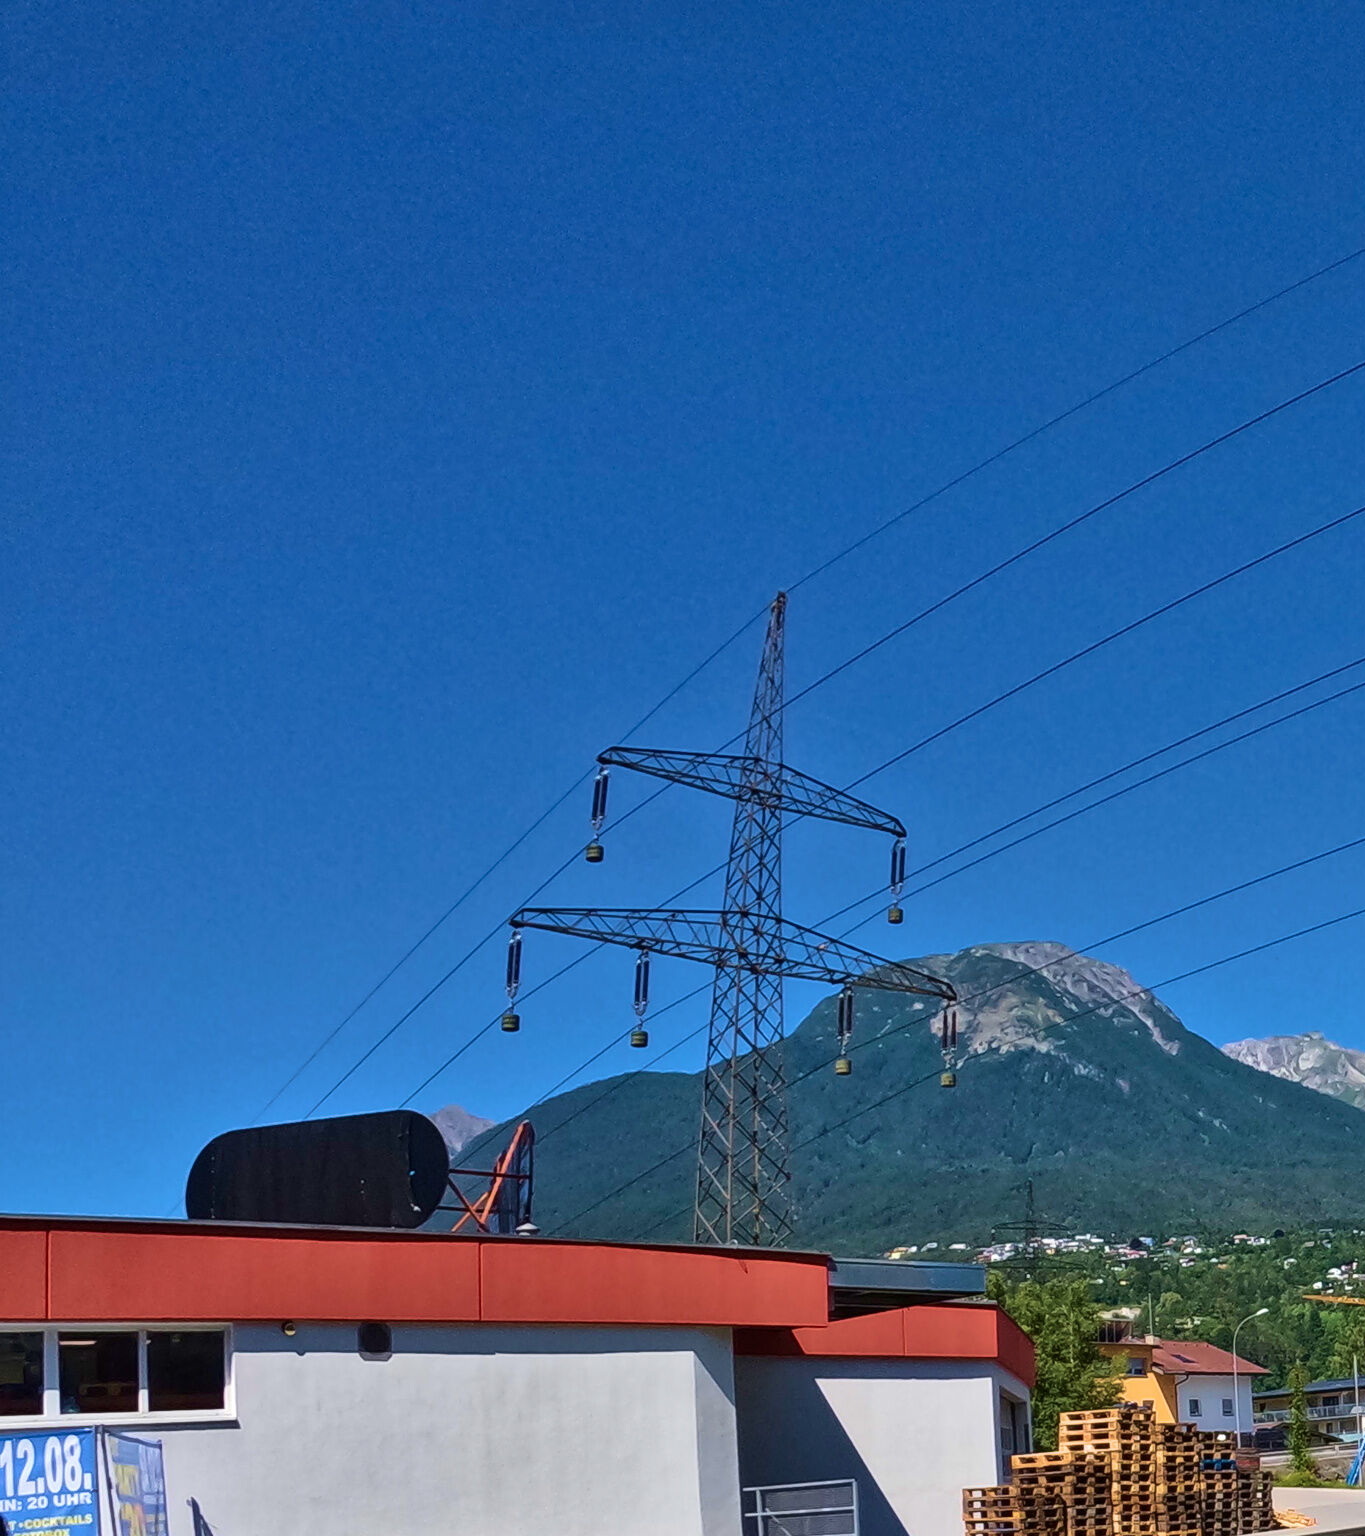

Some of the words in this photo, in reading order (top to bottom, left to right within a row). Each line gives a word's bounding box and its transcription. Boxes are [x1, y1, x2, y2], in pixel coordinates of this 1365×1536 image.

[0, 1434, 92, 1498] 12.08.
[27, 1496, 48, 1510] 20
[53, 1492, 92, 1507] UHR
[23, 1513, 93, 1529] COCKTAILS
